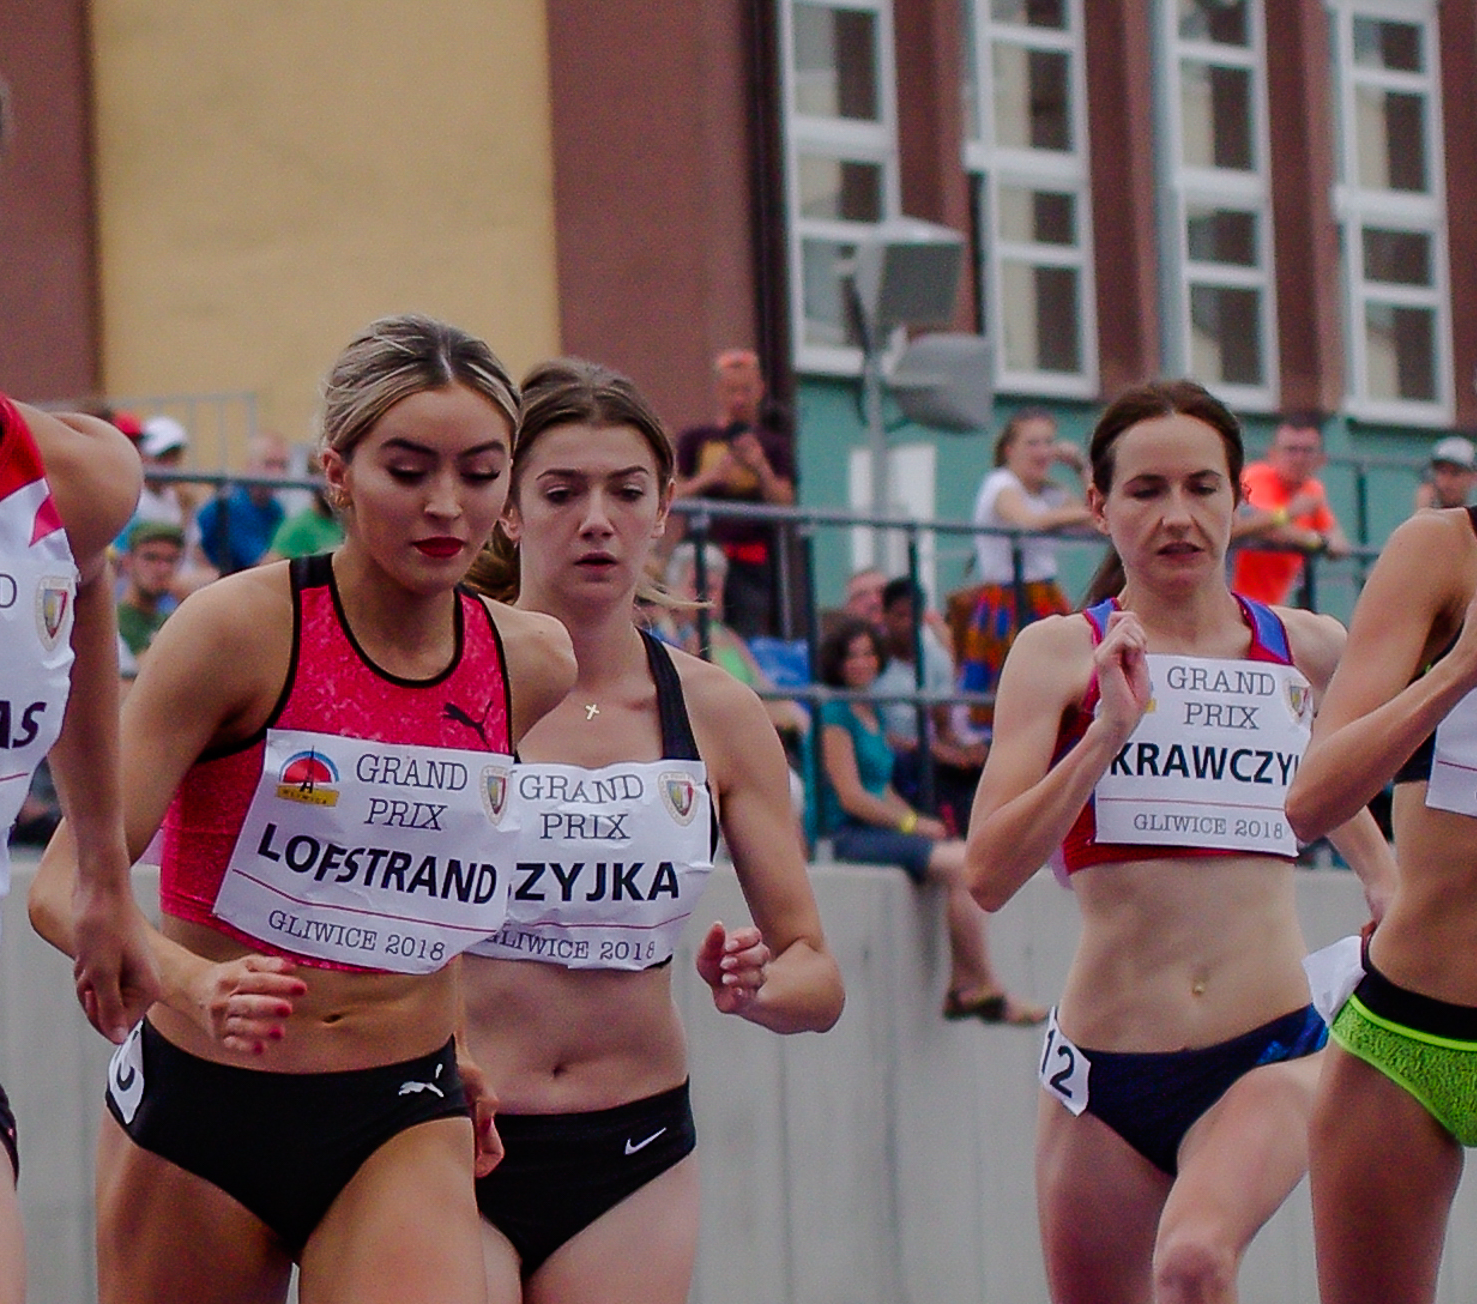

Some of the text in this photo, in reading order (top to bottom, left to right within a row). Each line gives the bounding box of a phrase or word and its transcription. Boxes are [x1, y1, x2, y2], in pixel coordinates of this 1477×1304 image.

[1167, 665, 1276, 697] GRAND
[1183, 702, 1260, 730] PRIX
[356, 754, 468, 791] GRAND
[1110, 742, 1299, 786] KRAWCZY
[519, 774, 644, 804] GRAND
[364, 798, 447, 831] PRIX
[540, 812, 631, 840] PRIX
[1133, 813, 1283, 839] GLIWICE 2018
[257, 822, 497, 904] LOFSTRAND
[508, 862, 679, 902] ZYJKA
[269, 909, 446, 961] GLIWICE 2018
[600, 941, 655, 961] 2018
[1042, 1029, 1075, 1098] 12
